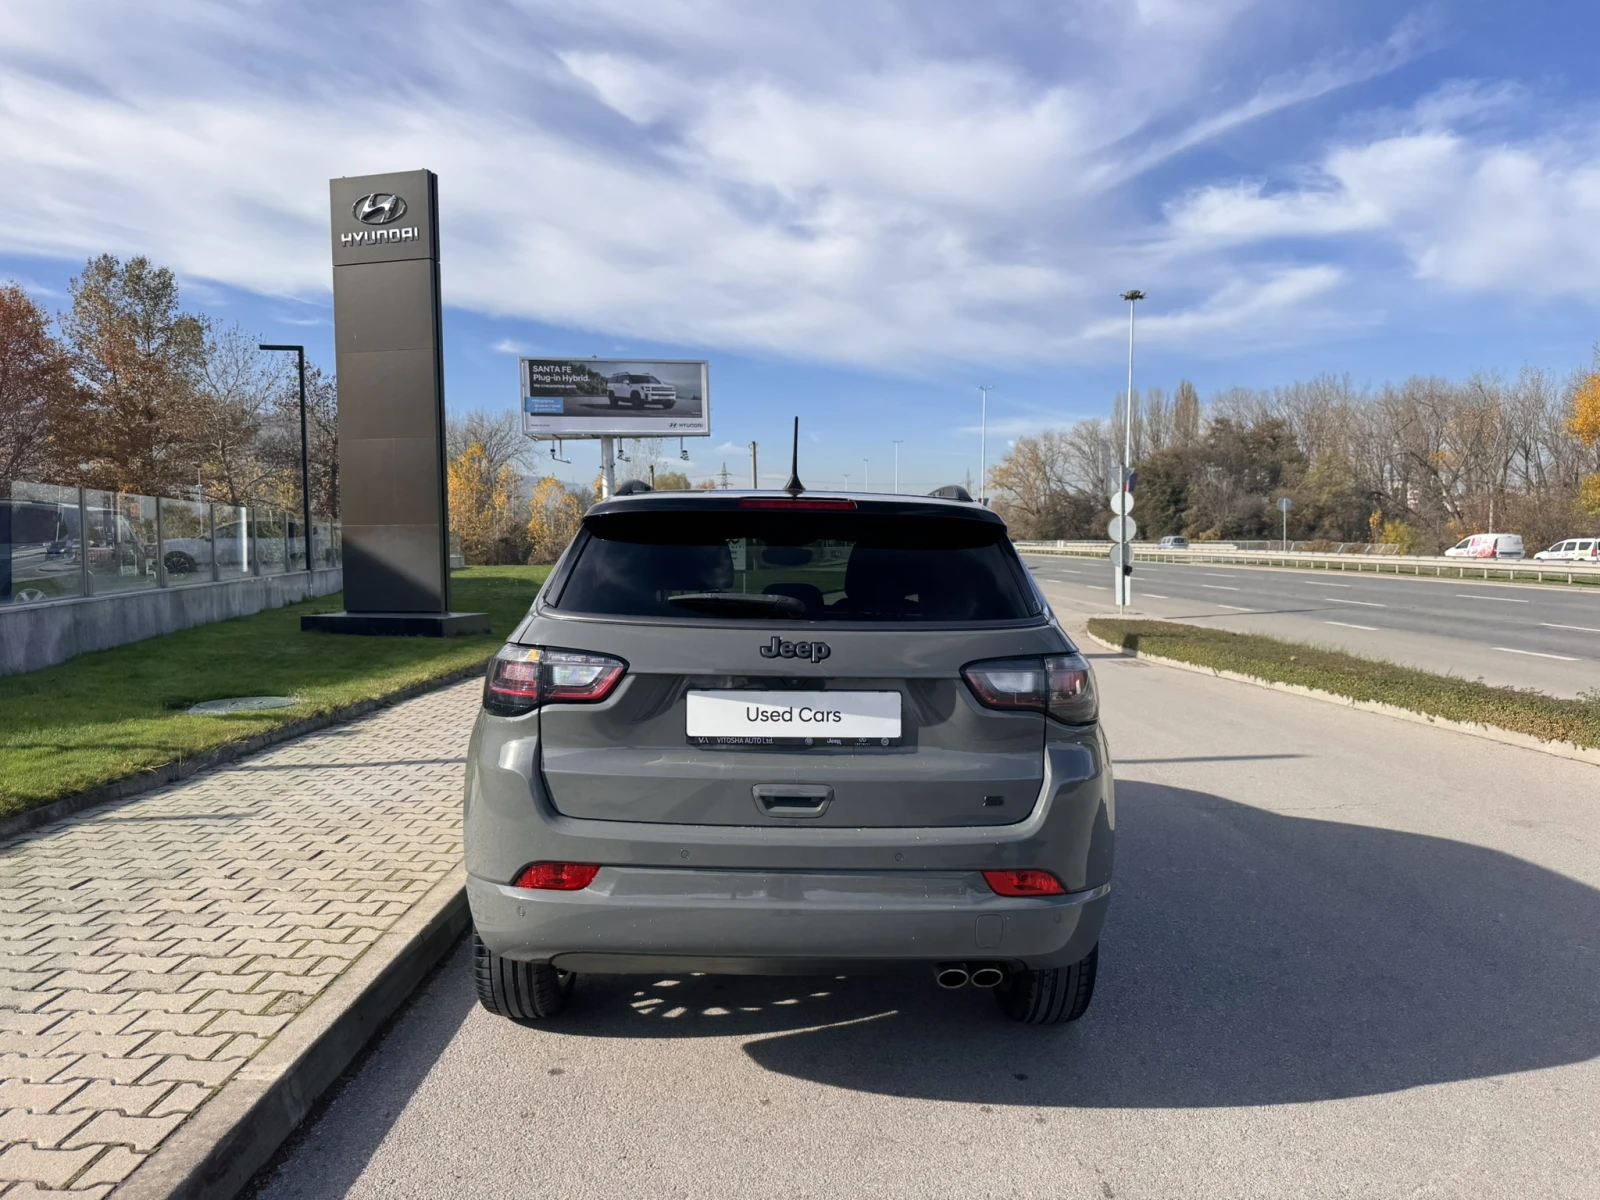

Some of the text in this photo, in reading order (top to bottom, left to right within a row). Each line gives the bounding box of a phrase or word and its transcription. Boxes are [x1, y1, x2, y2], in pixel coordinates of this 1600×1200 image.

[341, 227, 419, 248] HYUNDAI
[532, 365, 561, 373] SANTA
[533, 374, 590, 383] Plug-in Hybrid.
[760, 636, 831, 663] Jeep
[746, 706, 842, 722] Used Cars
[826, 737, 842, 745] Jeep
